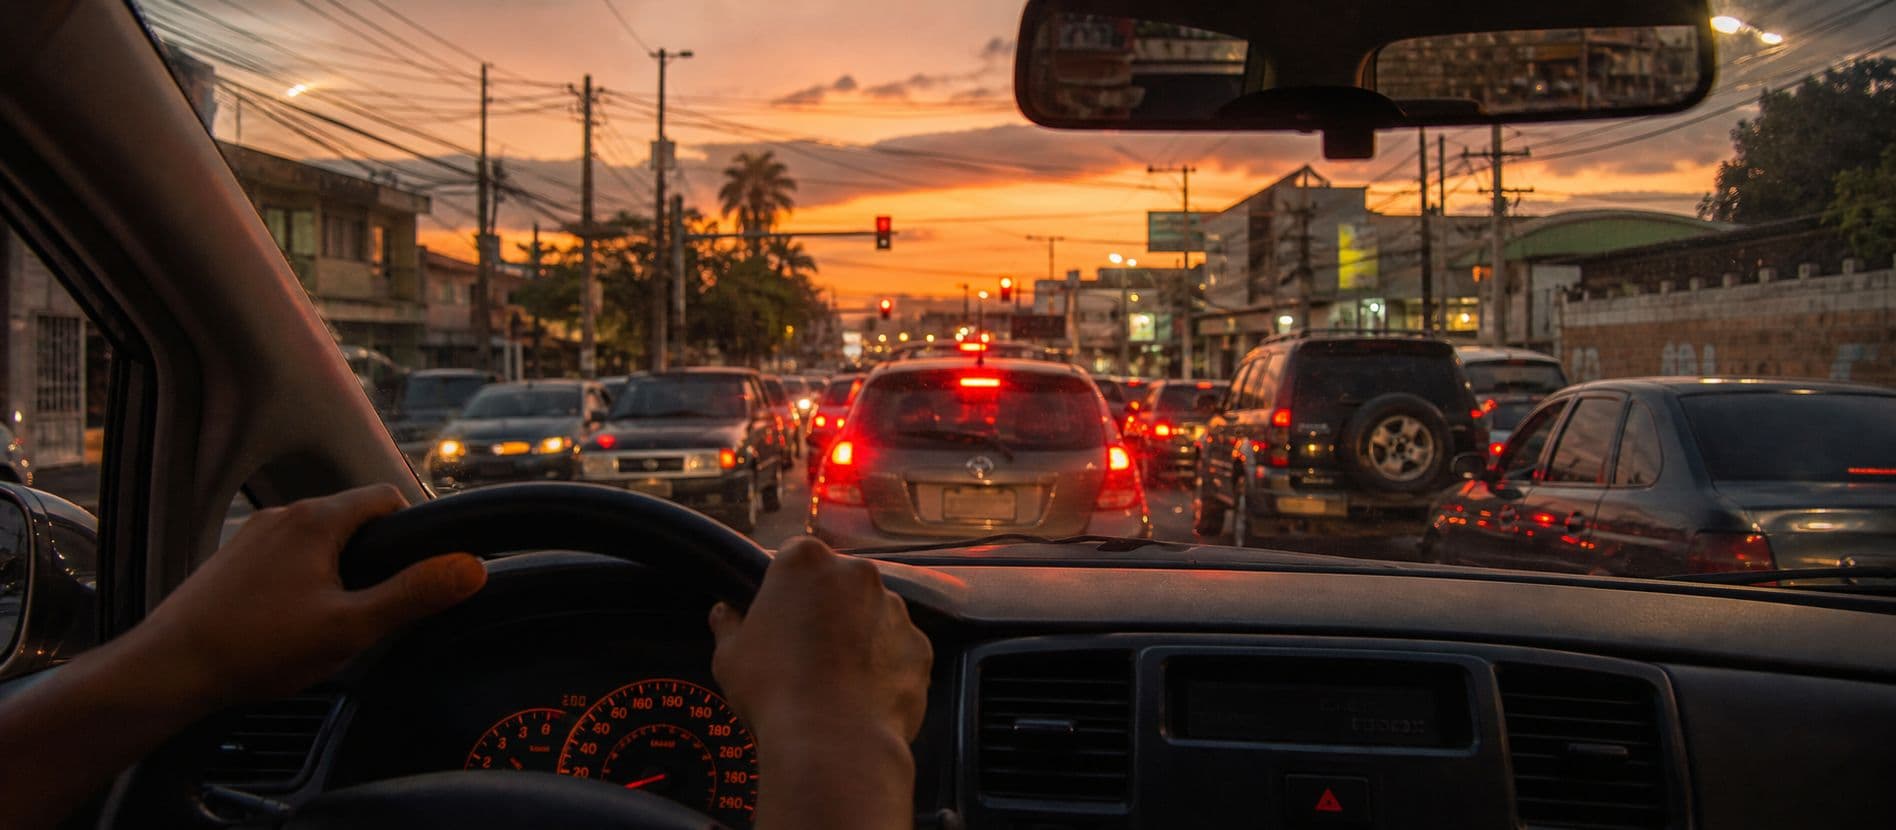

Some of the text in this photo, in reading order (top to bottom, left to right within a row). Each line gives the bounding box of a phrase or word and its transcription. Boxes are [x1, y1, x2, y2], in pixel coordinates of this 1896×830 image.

[580, 743, 597, 754] 40
[482, 756, 492, 768] 2
[573, 766, 589, 777] 20
